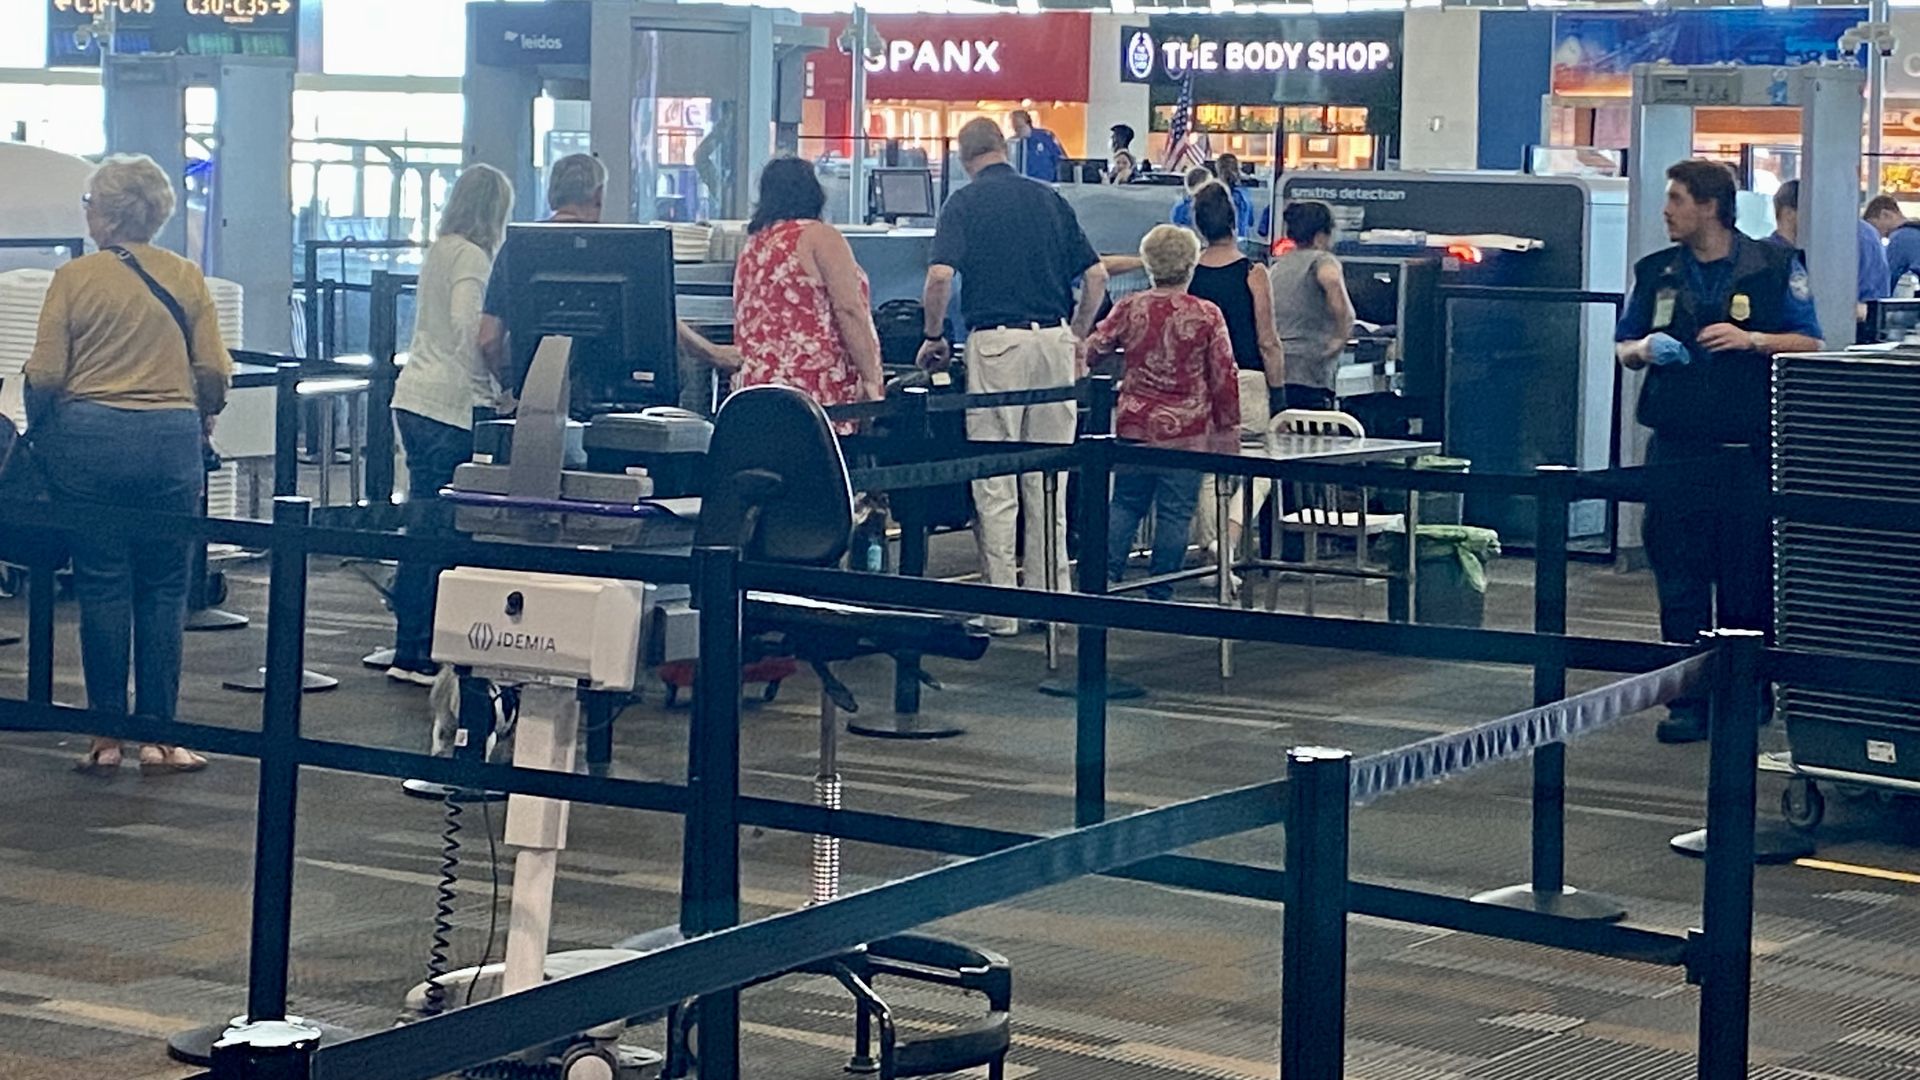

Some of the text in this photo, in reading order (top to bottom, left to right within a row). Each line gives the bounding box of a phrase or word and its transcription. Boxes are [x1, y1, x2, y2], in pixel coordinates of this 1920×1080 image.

[520, 33, 563, 49] leidos
[1162, 42, 1218, 70] THE
[1225, 42, 1304, 70] BODY
[1308, 42, 1390, 71] SHOP
[1291, 187, 1406, 200] smiths detection
[497, 631, 556, 652] IDEMIA
